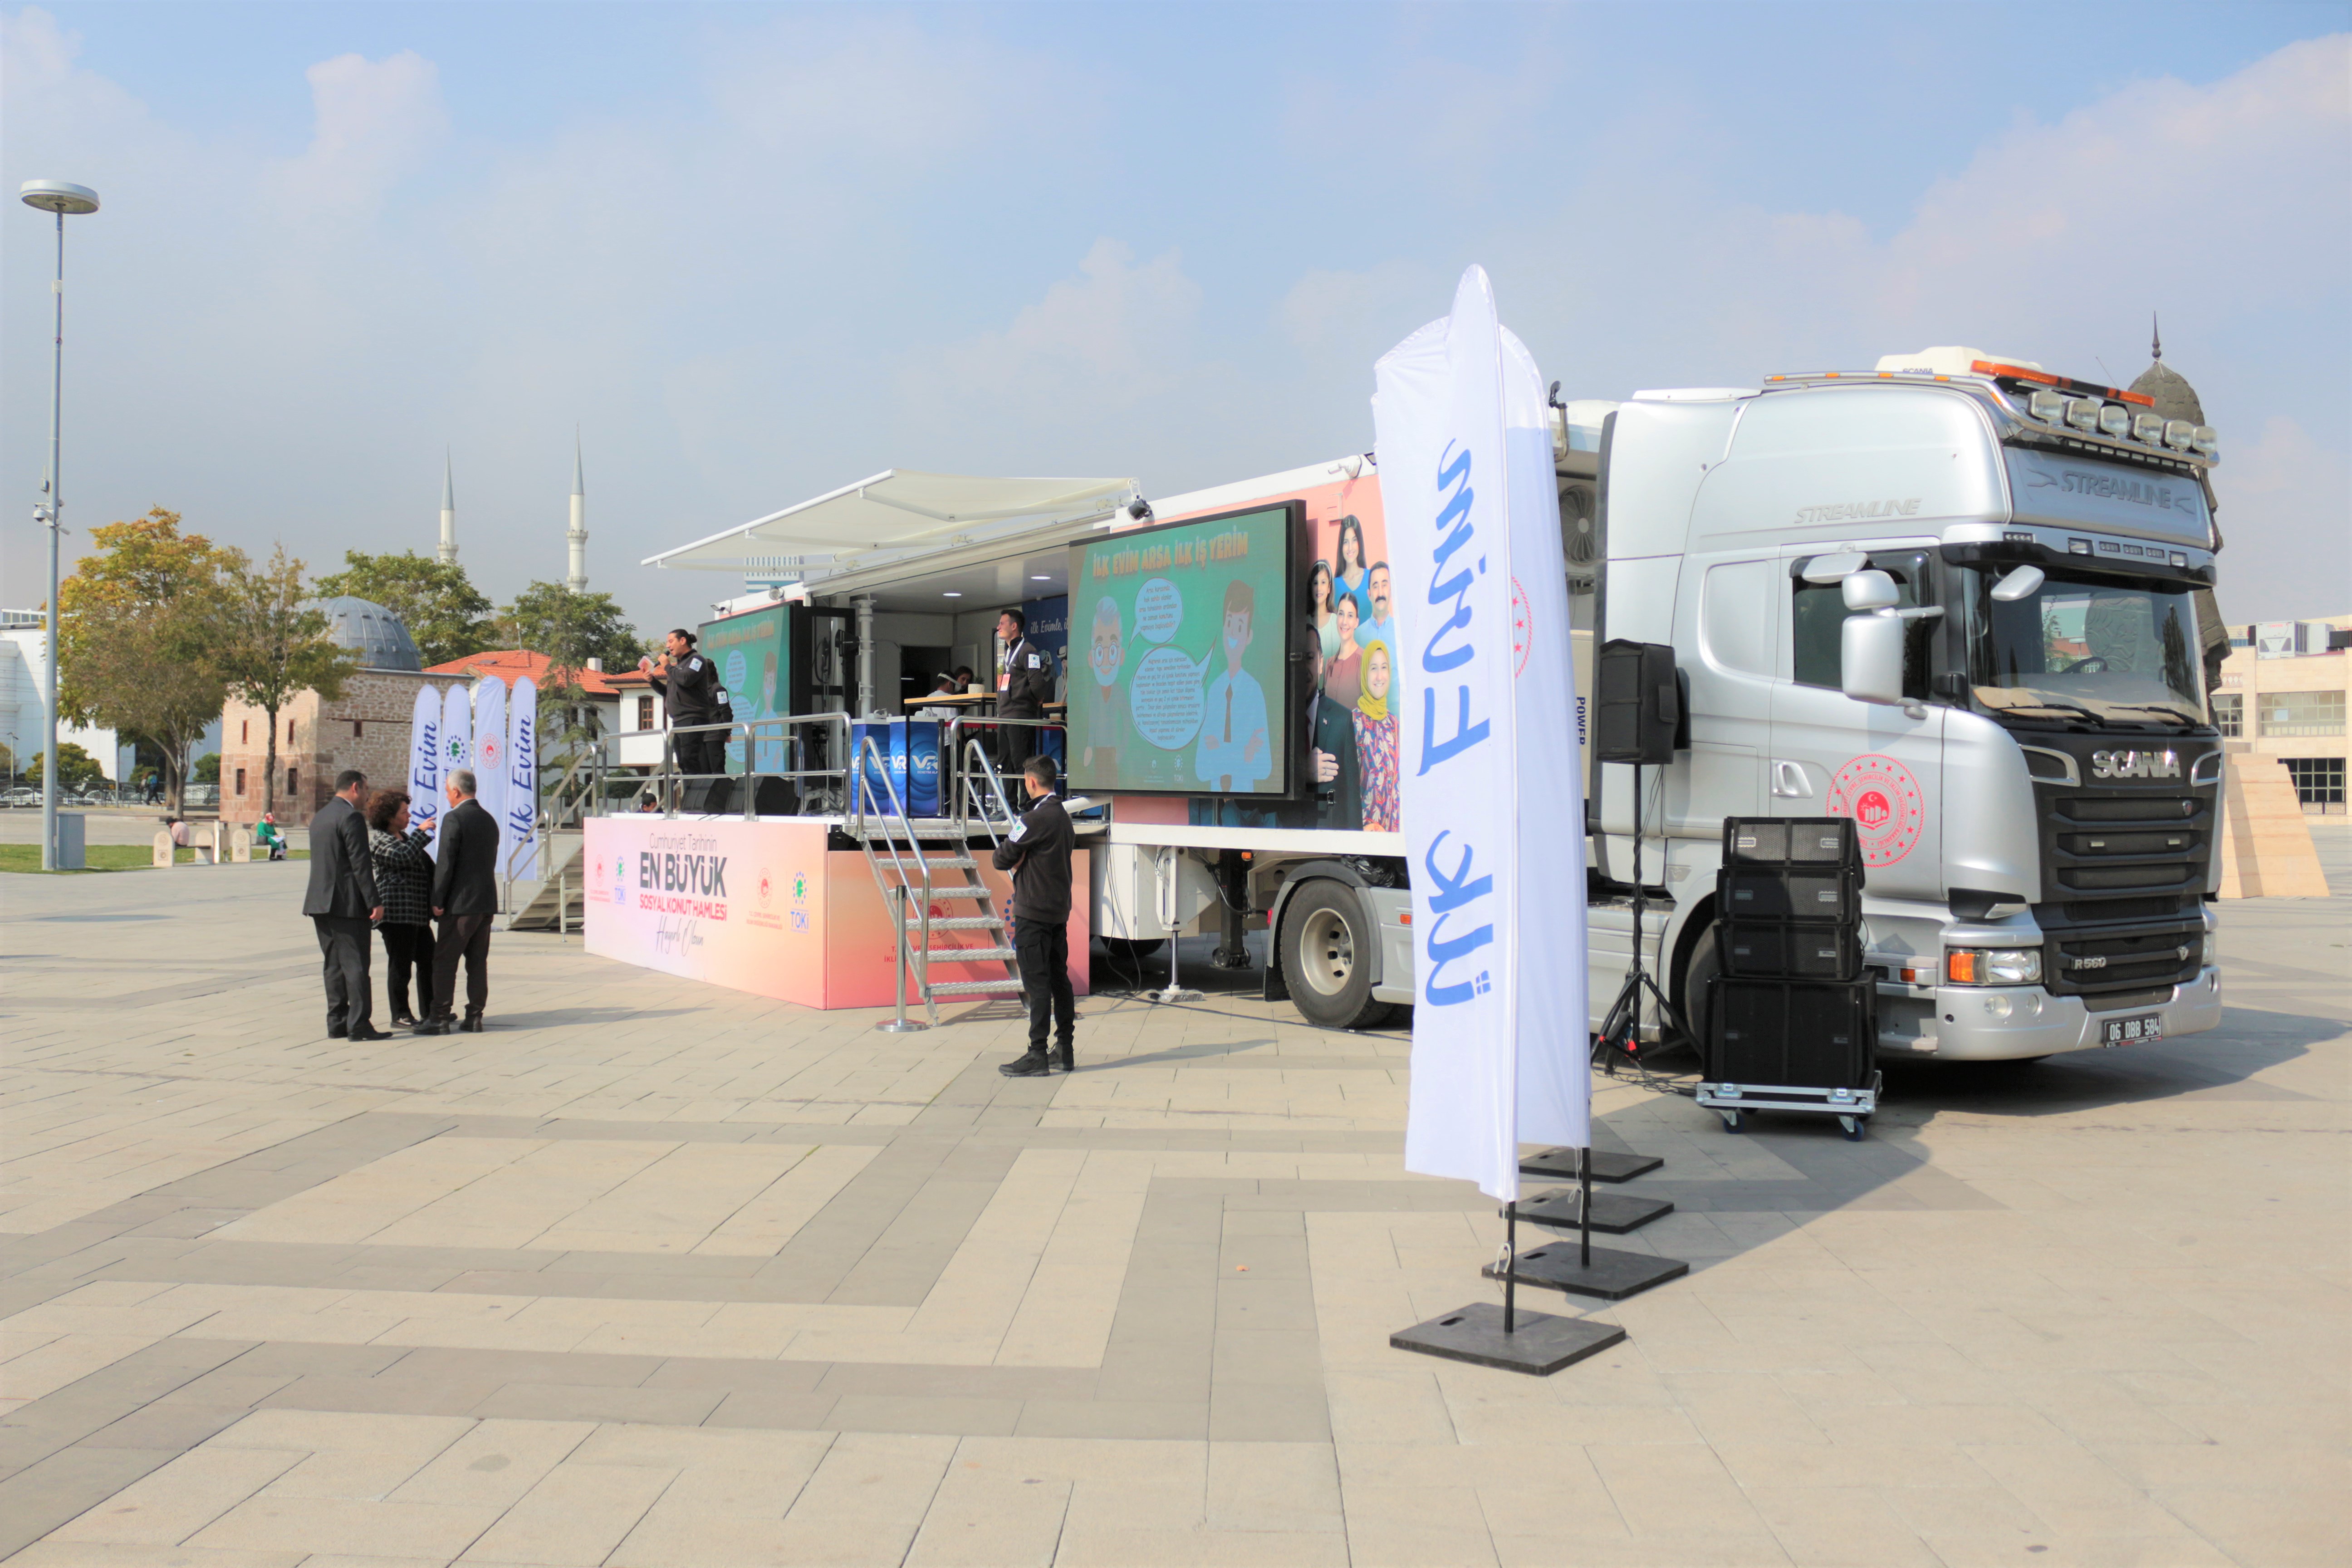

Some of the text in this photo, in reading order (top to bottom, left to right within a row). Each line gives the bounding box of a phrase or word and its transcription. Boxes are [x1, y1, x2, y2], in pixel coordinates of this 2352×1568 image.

[2061, 470, 2171, 510] STREAMLINE
[1794, 498, 1922, 523] STREAMLINE
[1142, 545, 1171, 570] ARSA
[414, 721, 437, 792] Evim
[512, 715, 532, 791] Evim
[891, 755, 906, 769] VR
[2092, 750, 2181, 778] SCANIA
[650, 833, 717, 853] Cumhuriyet Tarihinin
[640, 852, 727, 898] EN BÜYÜK
[640, 894, 727, 921] SOSYAL KONUT HAMLESİ
[682, 917, 703, 956] Olsun
[2110, 1018, 2159, 1040] 06 DBB 584
